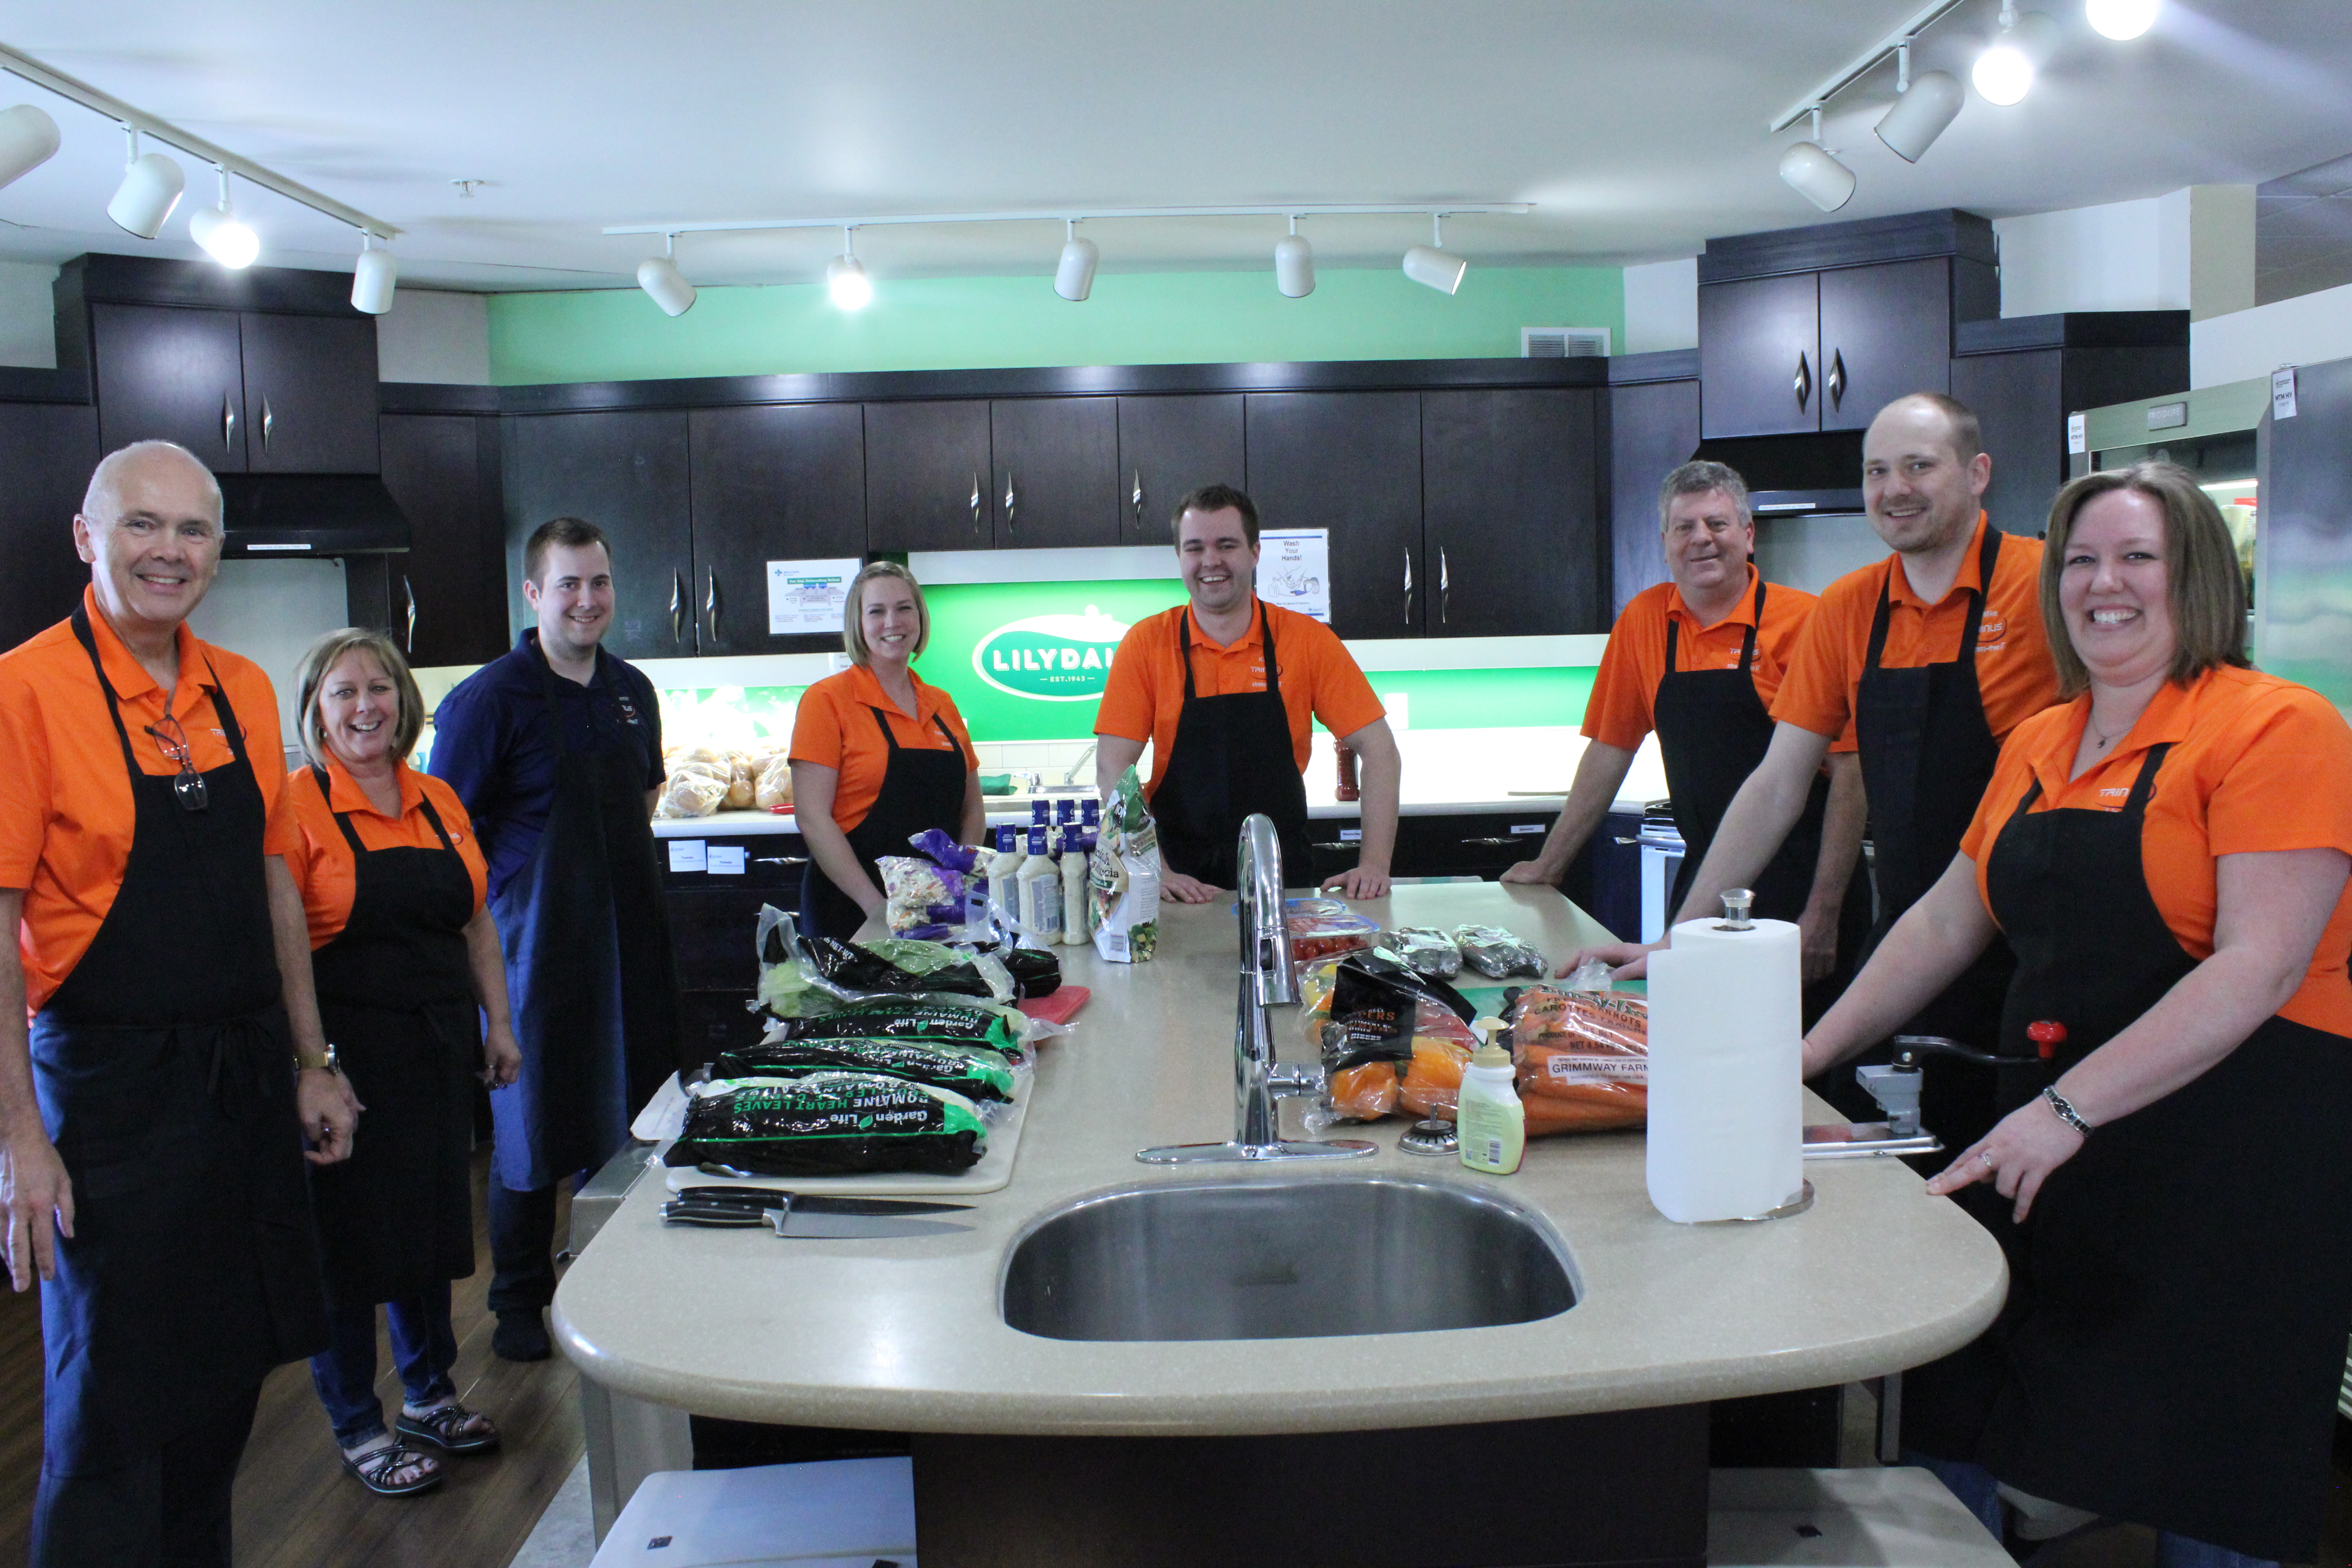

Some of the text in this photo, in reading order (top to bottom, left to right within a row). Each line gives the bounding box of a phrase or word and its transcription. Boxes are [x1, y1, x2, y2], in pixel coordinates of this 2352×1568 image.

[2148, 408, 2180, 420] FRIGIDAIRE
[2100, 788, 2130, 797] TRIN
[894, 1019, 974, 1029] Garden Life
[1570, 1041, 1584, 1049] NET
[1553, 1063, 1616, 1073] GRIMMWAY
[734, 1093, 929, 1114] ROMAINE HEART LEAVES
[830, 1110, 927, 1125] Garden Life
